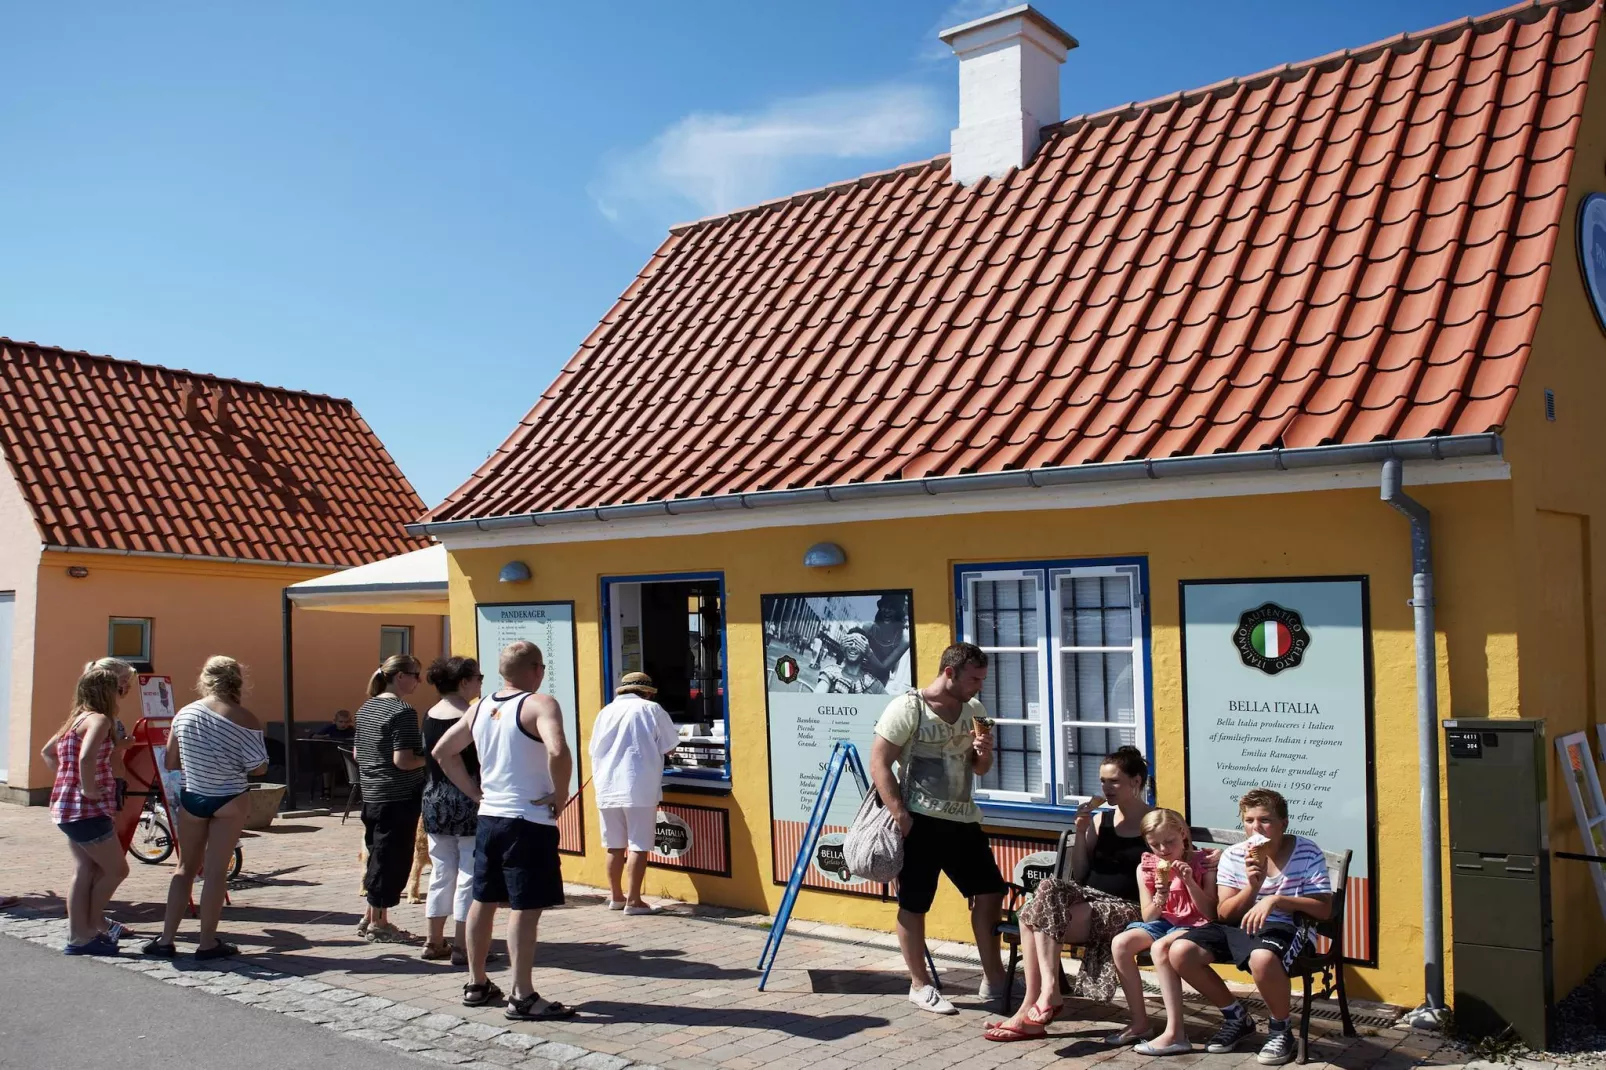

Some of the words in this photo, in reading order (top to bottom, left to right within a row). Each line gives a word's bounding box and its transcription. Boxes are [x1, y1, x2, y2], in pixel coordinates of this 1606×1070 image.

[501, 610, 546, 619] PANDEKAGER
[1248, 608, 1302, 632] AUTENTICO
[1239, 628, 1266, 669] ITALIANO
[1276, 639, 1305, 669] GELATO
[817, 705, 858, 716] GELATO
[1228, 700, 1271, 713] BELLA
[1274, 701, 1320, 714] ITALIA
[797, 724, 815, 732] Piccolo
[1216, 718, 1235, 727] Bella
[1237, 719, 1258, 727] Italia
[1260, 720, 1300, 729] produceres
[1308, 721, 1335, 730] Italien
[797, 732, 813, 740] Medio
[1209, 732, 1218, 742] af
[1218, 733, 1272, 744] familiefirmaet
[1275, 735, 1301, 744] Indian
[1309, 738, 1343, 747] regionen
[1241, 748, 1267, 758] Emilia
[1216, 762, 1268, 772] Virksomheden
[1270, 765, 1286, 774] blev
[1288, 766, 1327, 778] grundlagt
[1329, 768, 1339, 779] af
[800, 780, 816, 788] Medio
[1222, 777, 1259, 787] Gogliardo
[1261, 779, 1281, 788] Olivi
[1283, 781, 1287, 789] i
[1308, 799, 1323, 808] dag
[1297, 814, 1315, 822] efter
[665, 829, 685, 837] ITALIA
[821, 849, 845, 860] BELLA
